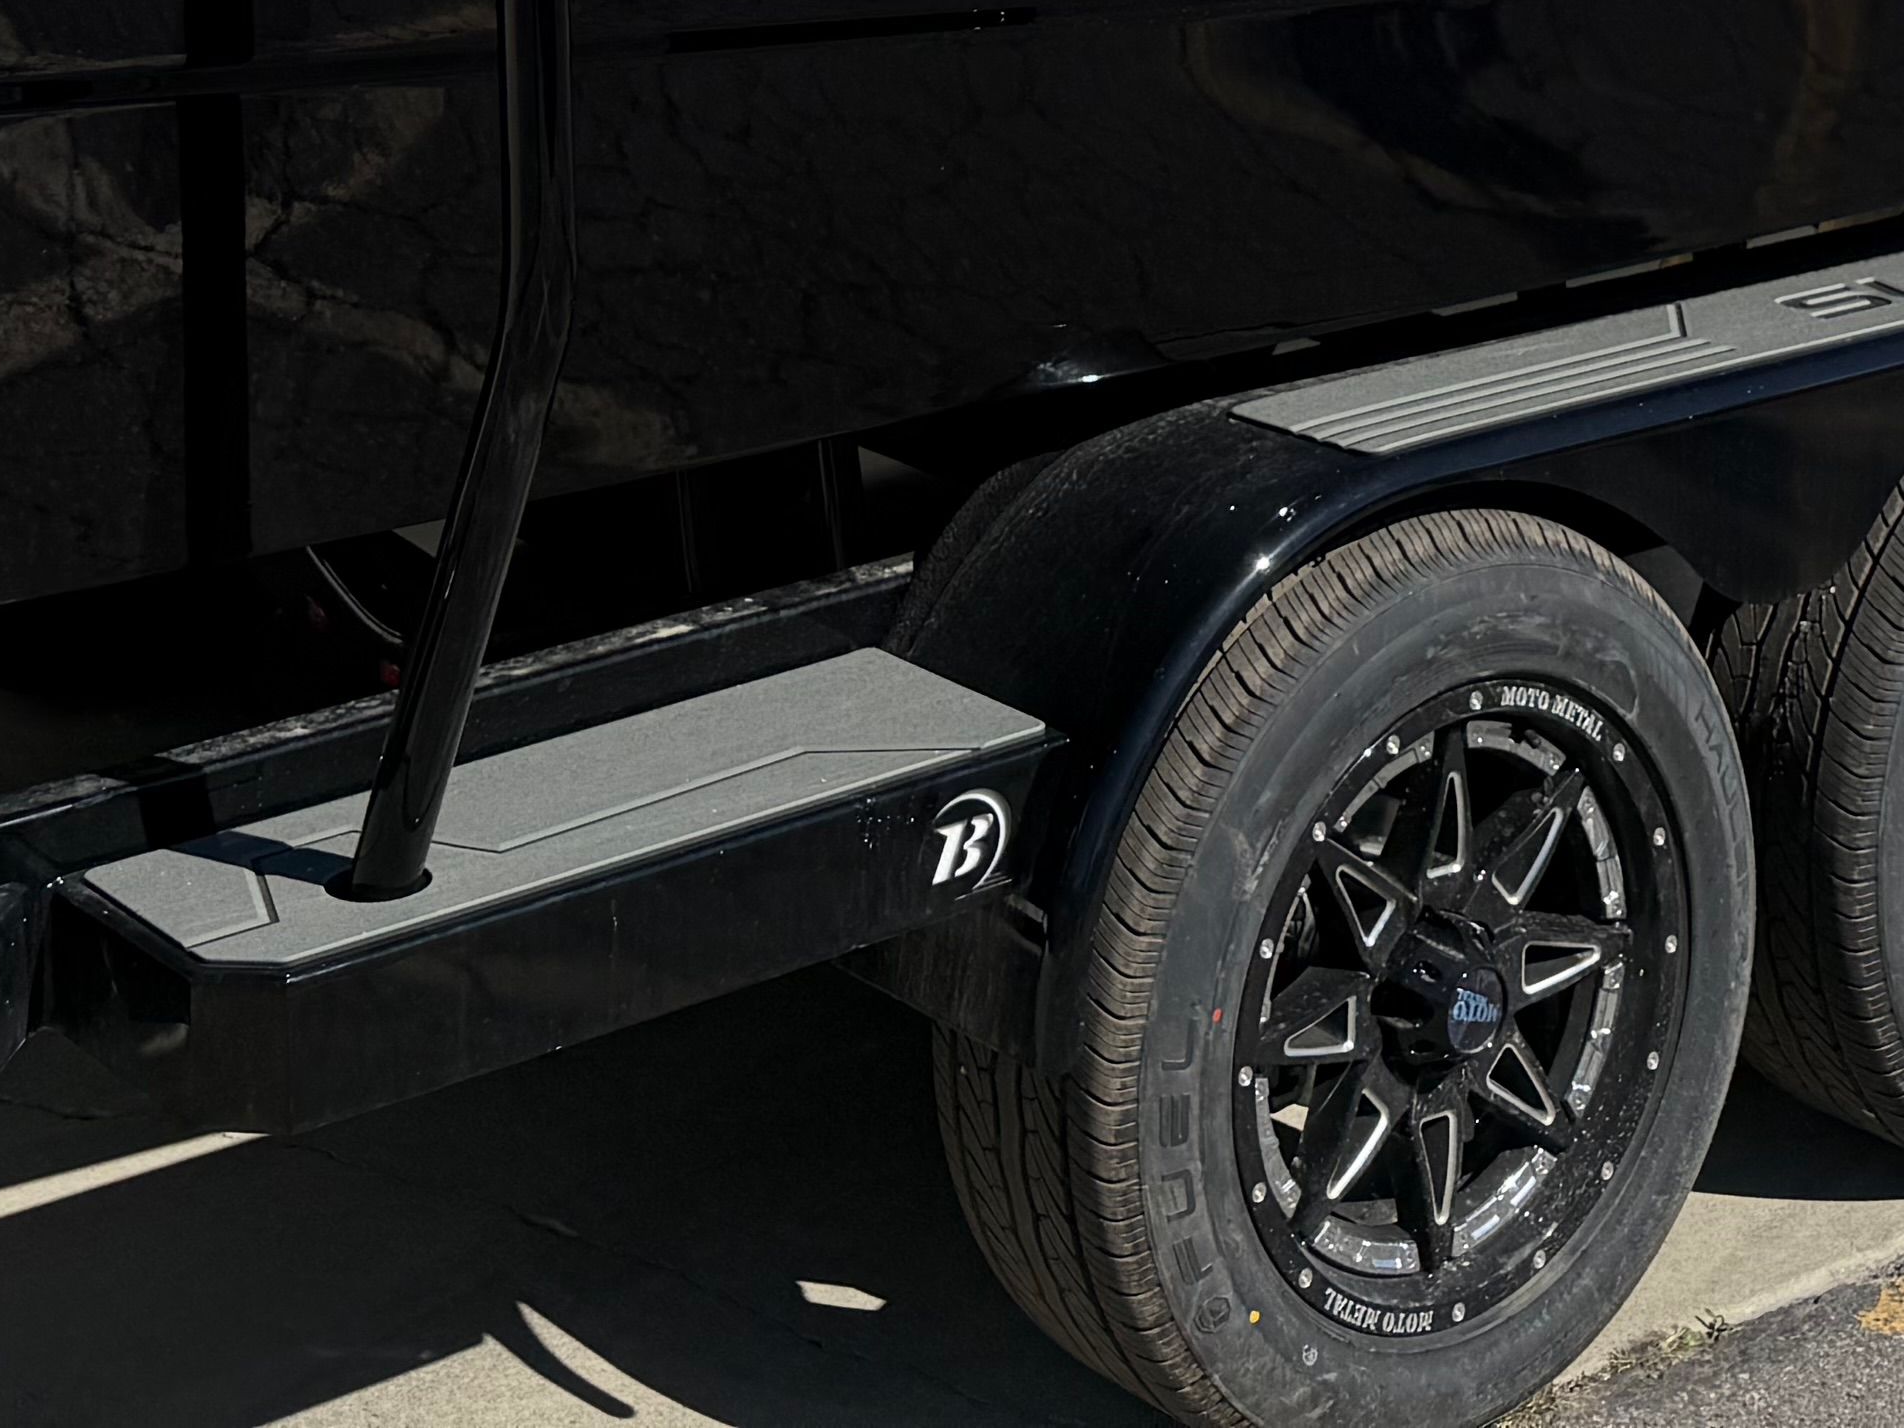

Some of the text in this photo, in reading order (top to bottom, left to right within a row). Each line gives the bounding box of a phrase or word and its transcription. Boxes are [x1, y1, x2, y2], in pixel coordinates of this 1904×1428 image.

[1500, 685, 1604, 742] MOTO METAL
[1324, 1287, 1434, 1334] MOTO METAL
